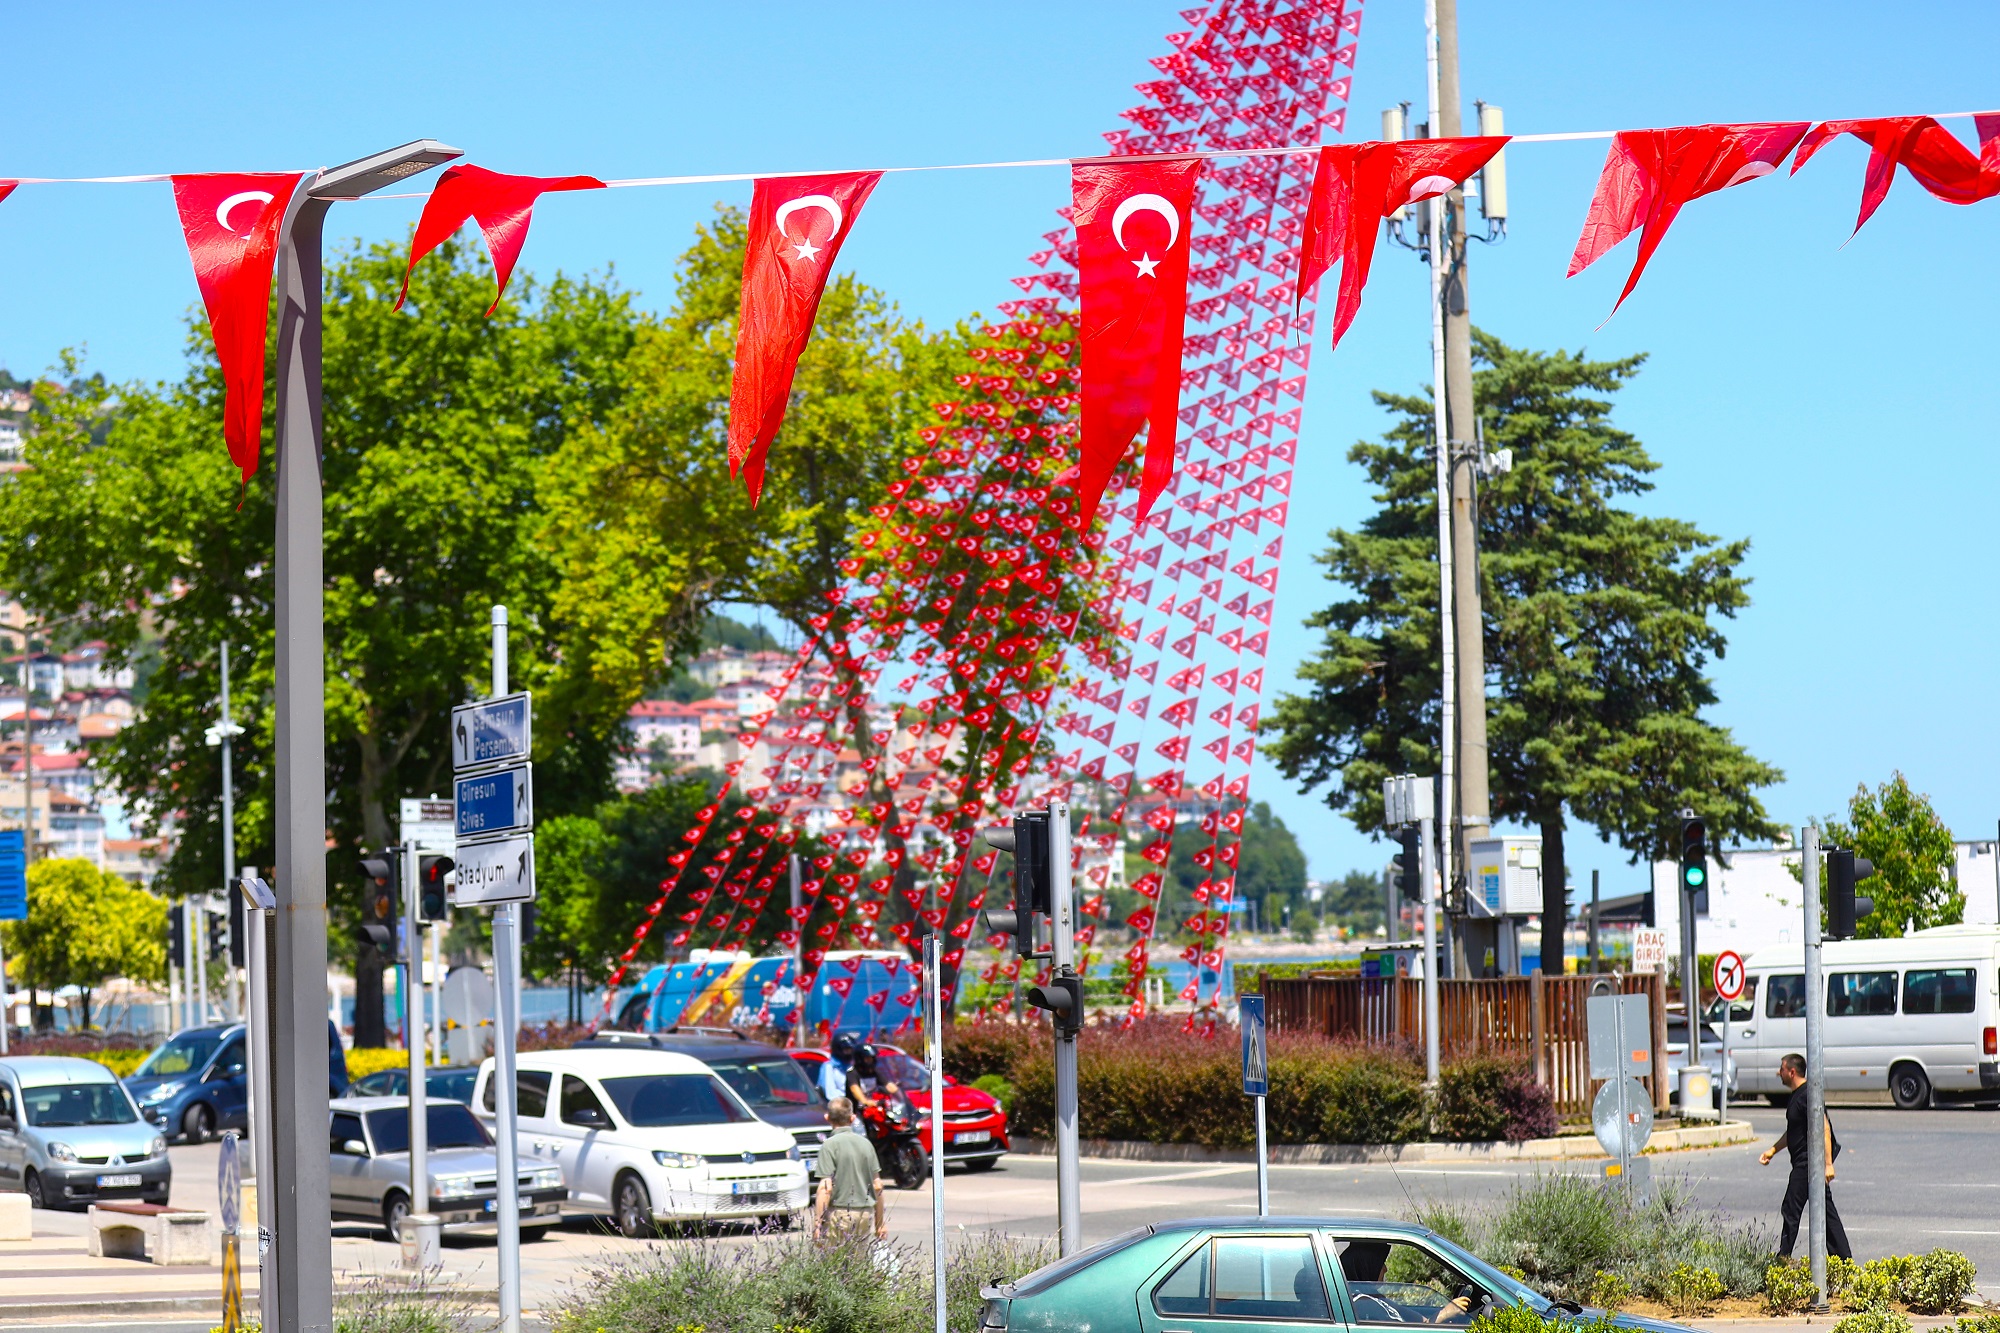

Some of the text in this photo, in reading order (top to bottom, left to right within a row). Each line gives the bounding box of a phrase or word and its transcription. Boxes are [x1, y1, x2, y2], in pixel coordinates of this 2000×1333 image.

[474, 709, 515, 731] Samsun
[461, 782, 496, 802] Giresun
[461, 811, 484, 830] Sivas
[458, 861, 505, 889] Stadyum
[1636, 932, 1665, 947] ARAÇ
